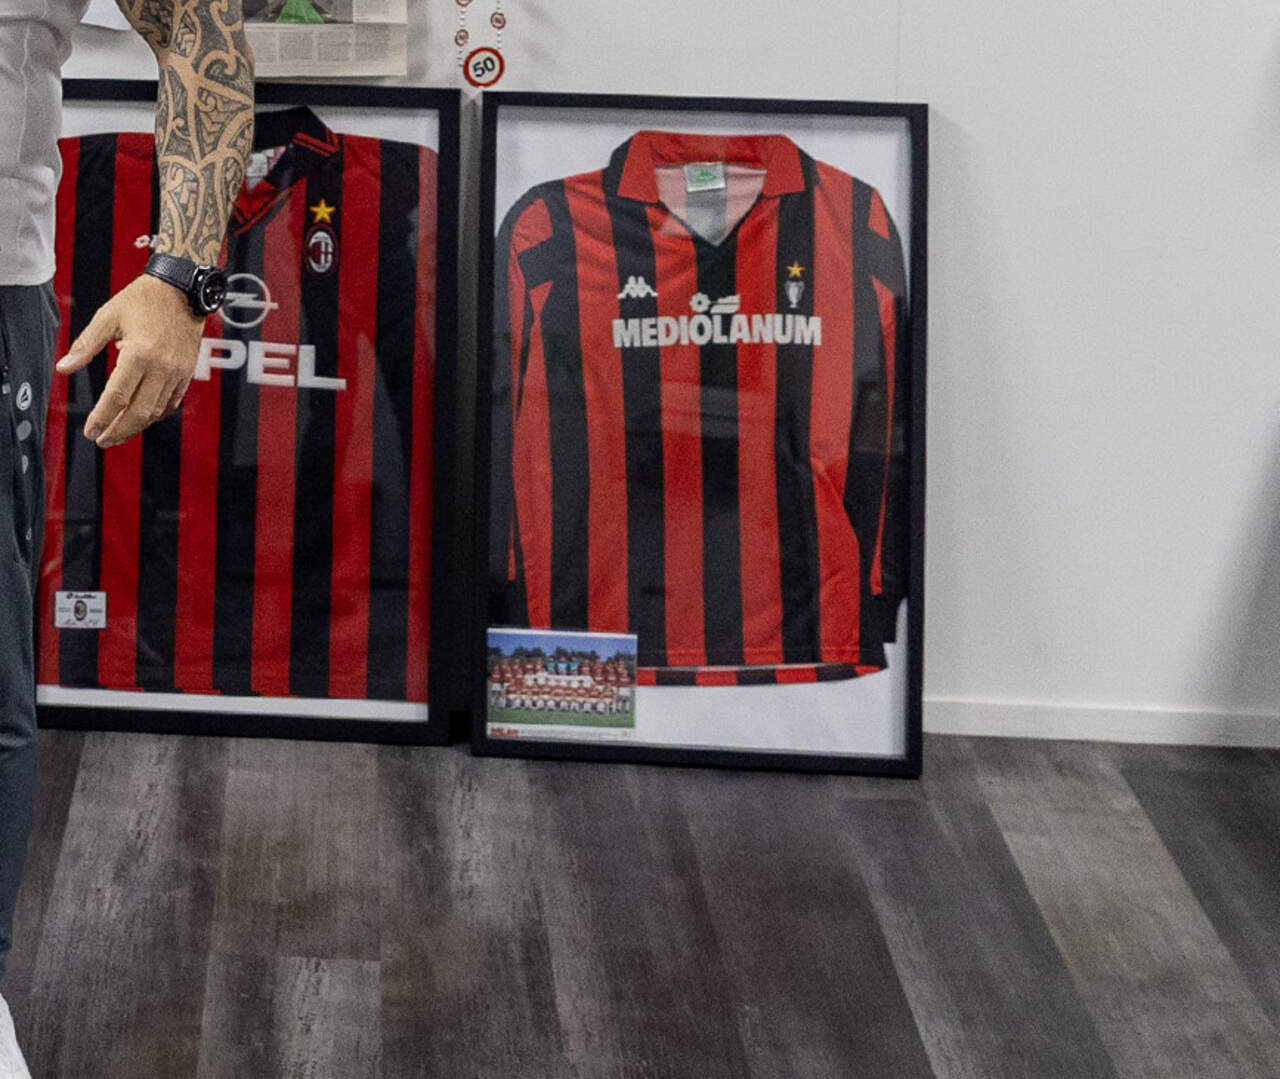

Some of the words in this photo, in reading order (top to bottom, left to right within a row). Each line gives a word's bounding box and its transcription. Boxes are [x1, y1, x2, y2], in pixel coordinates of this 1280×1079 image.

[473, 56, 495, 78] 50
[612, 314, 822, 348] MEDIOLANUM
[194, 338, 347, 390] PEL
